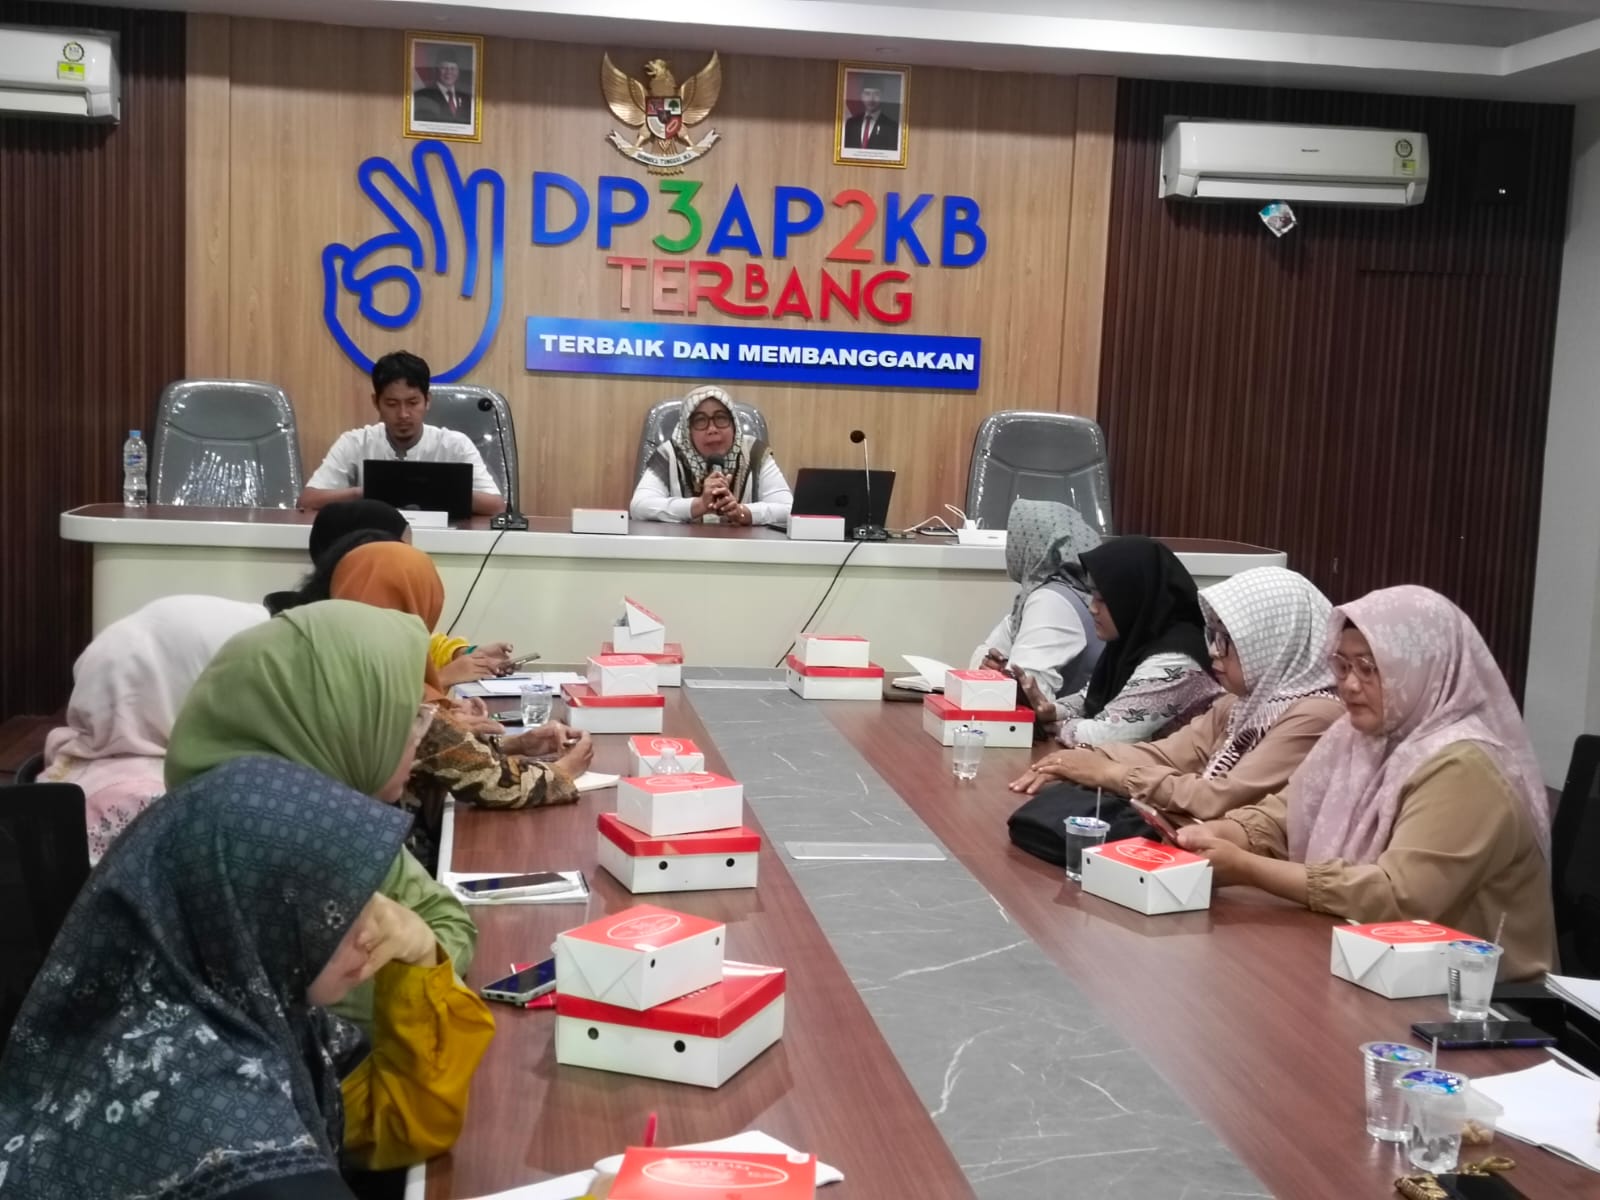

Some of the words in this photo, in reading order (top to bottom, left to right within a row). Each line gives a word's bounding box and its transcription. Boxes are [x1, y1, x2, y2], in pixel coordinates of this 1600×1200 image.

[531, 171, 987, 268] DP3AP2KB
[607, 256, 913, 324] TERBANG
[539, 334, 665, 358] TERBAIK
[673, 341, 730, 361] DAN
[739, 344, 975, 371] MEMBANGGAKAN
